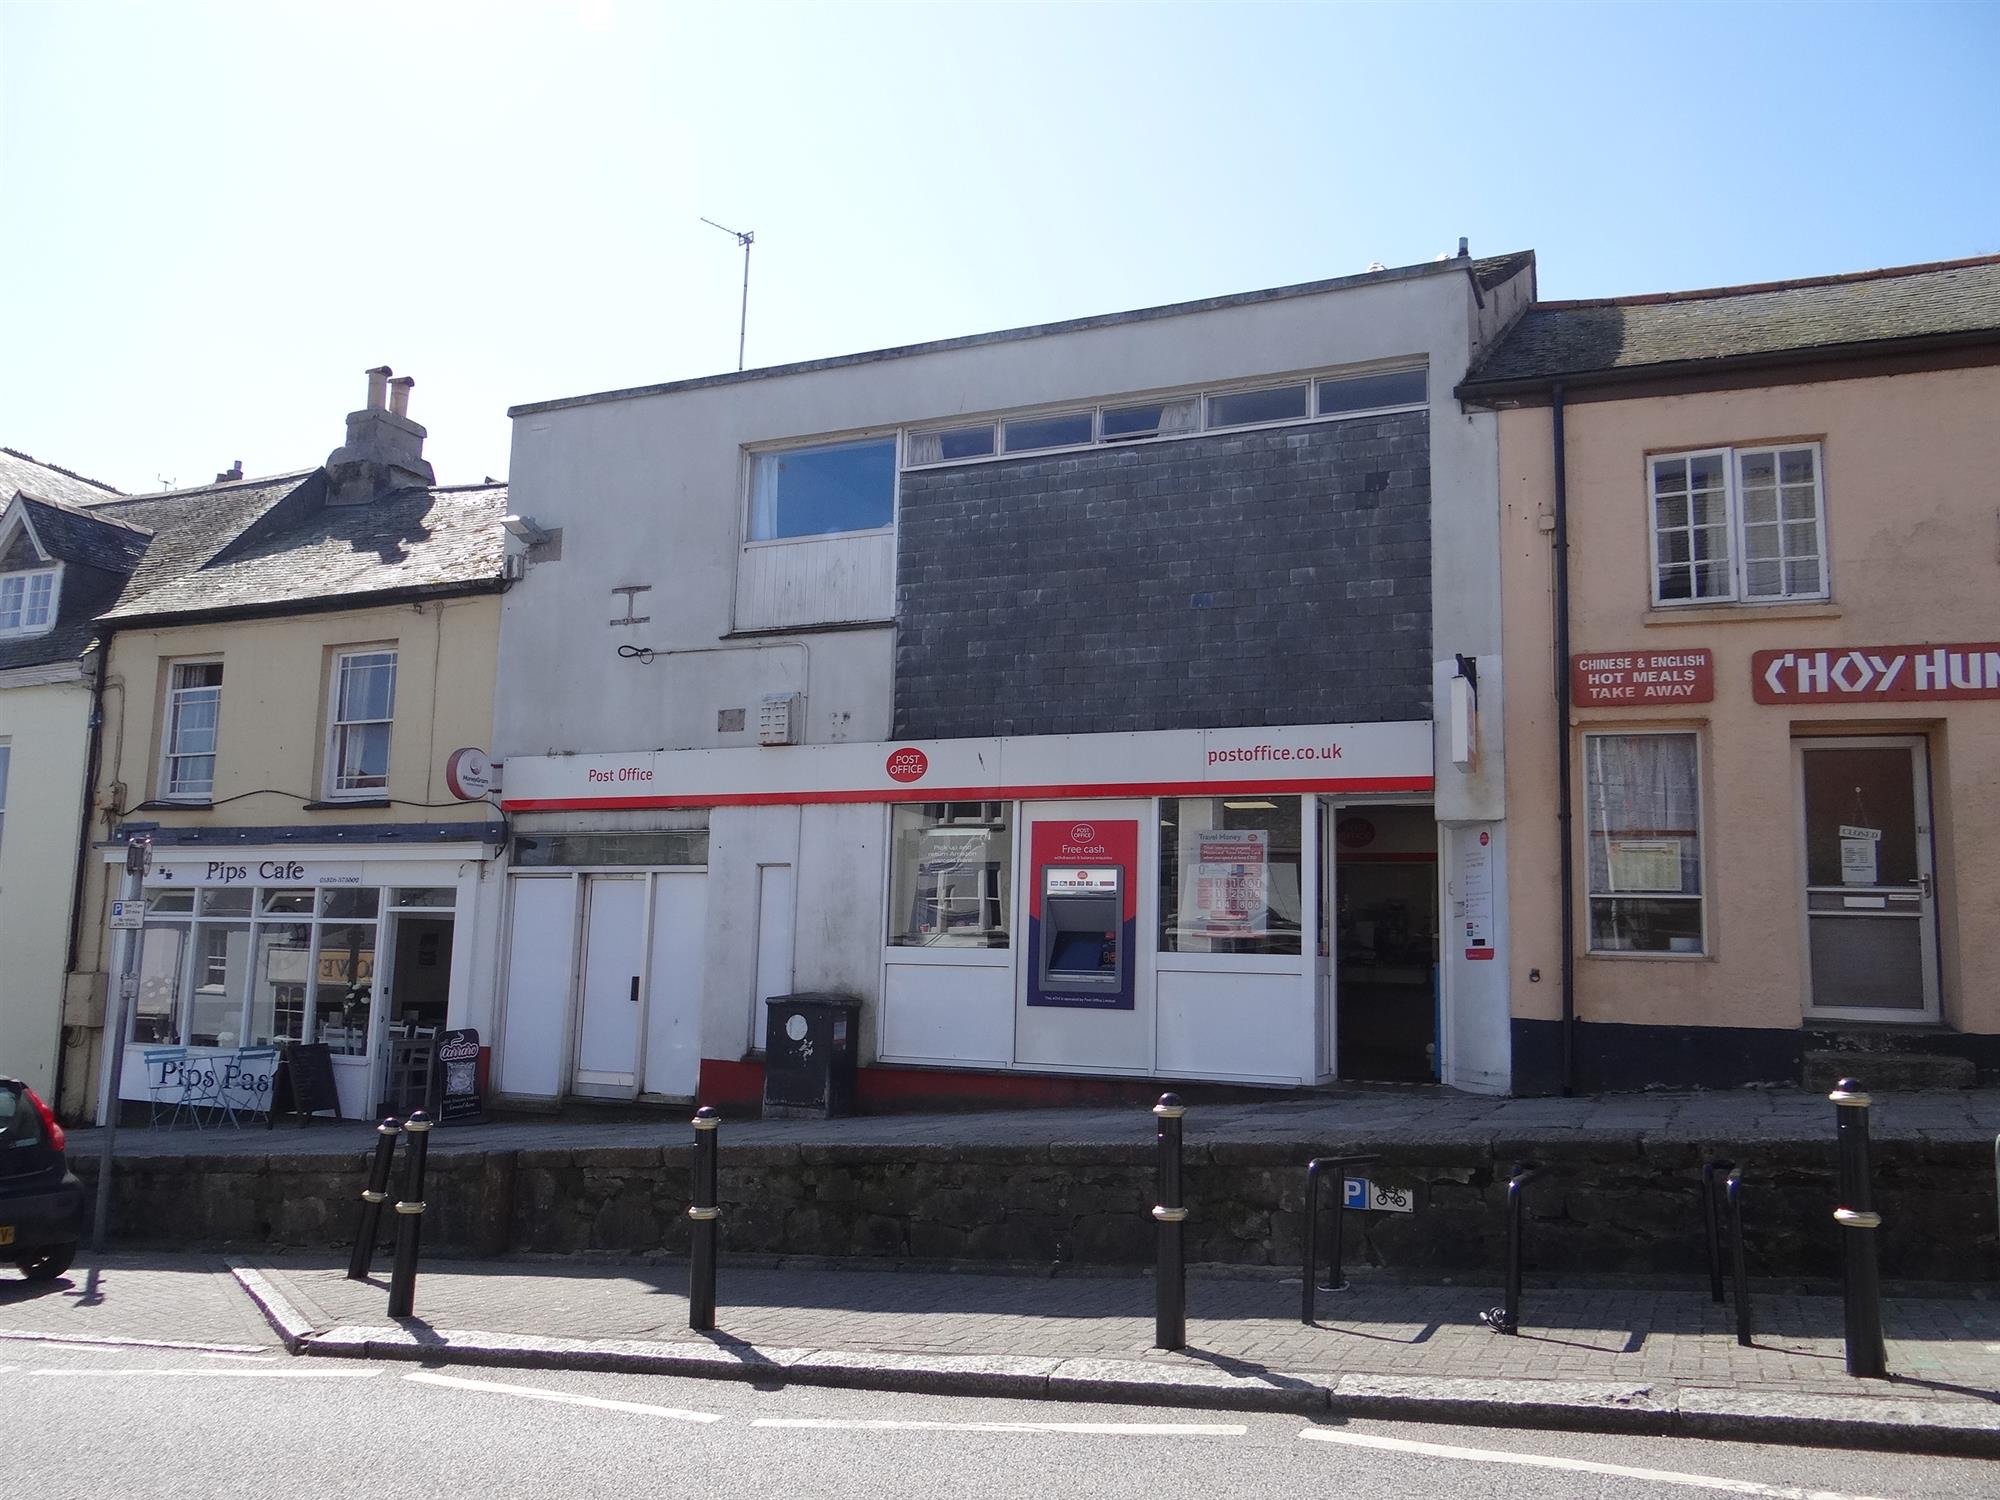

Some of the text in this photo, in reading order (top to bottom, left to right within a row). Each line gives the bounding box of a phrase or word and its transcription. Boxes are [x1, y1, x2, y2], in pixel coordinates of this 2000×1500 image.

[1579, 655, 1705, 671] CHINESE & ENGLISH
[1588, 669, 1696, 685] HOT MEALS
[1764, 652, 1906, 693] CHOY
[1589, 684, 1695, 699] TAKE AWAY
[895, 754, 920, 764] POST
[1208, 743, 1343, 766] postoffice.co.uk
[588, 767, 653, 782] Post Office
[889, 764, 923, 775] OFFICE
[1219, 833, 1242, 842] Money
[1842, 828, 1879, 838] CLOSED
[1062, 844, 1105, 854] Free cash
[205, 860, 305, 885] Pips Cafe
[114, 903, 122, 914] P
[159, 1060, 275, 1092] Pips Pas
[1344, 1180, 1361, 1205] P
